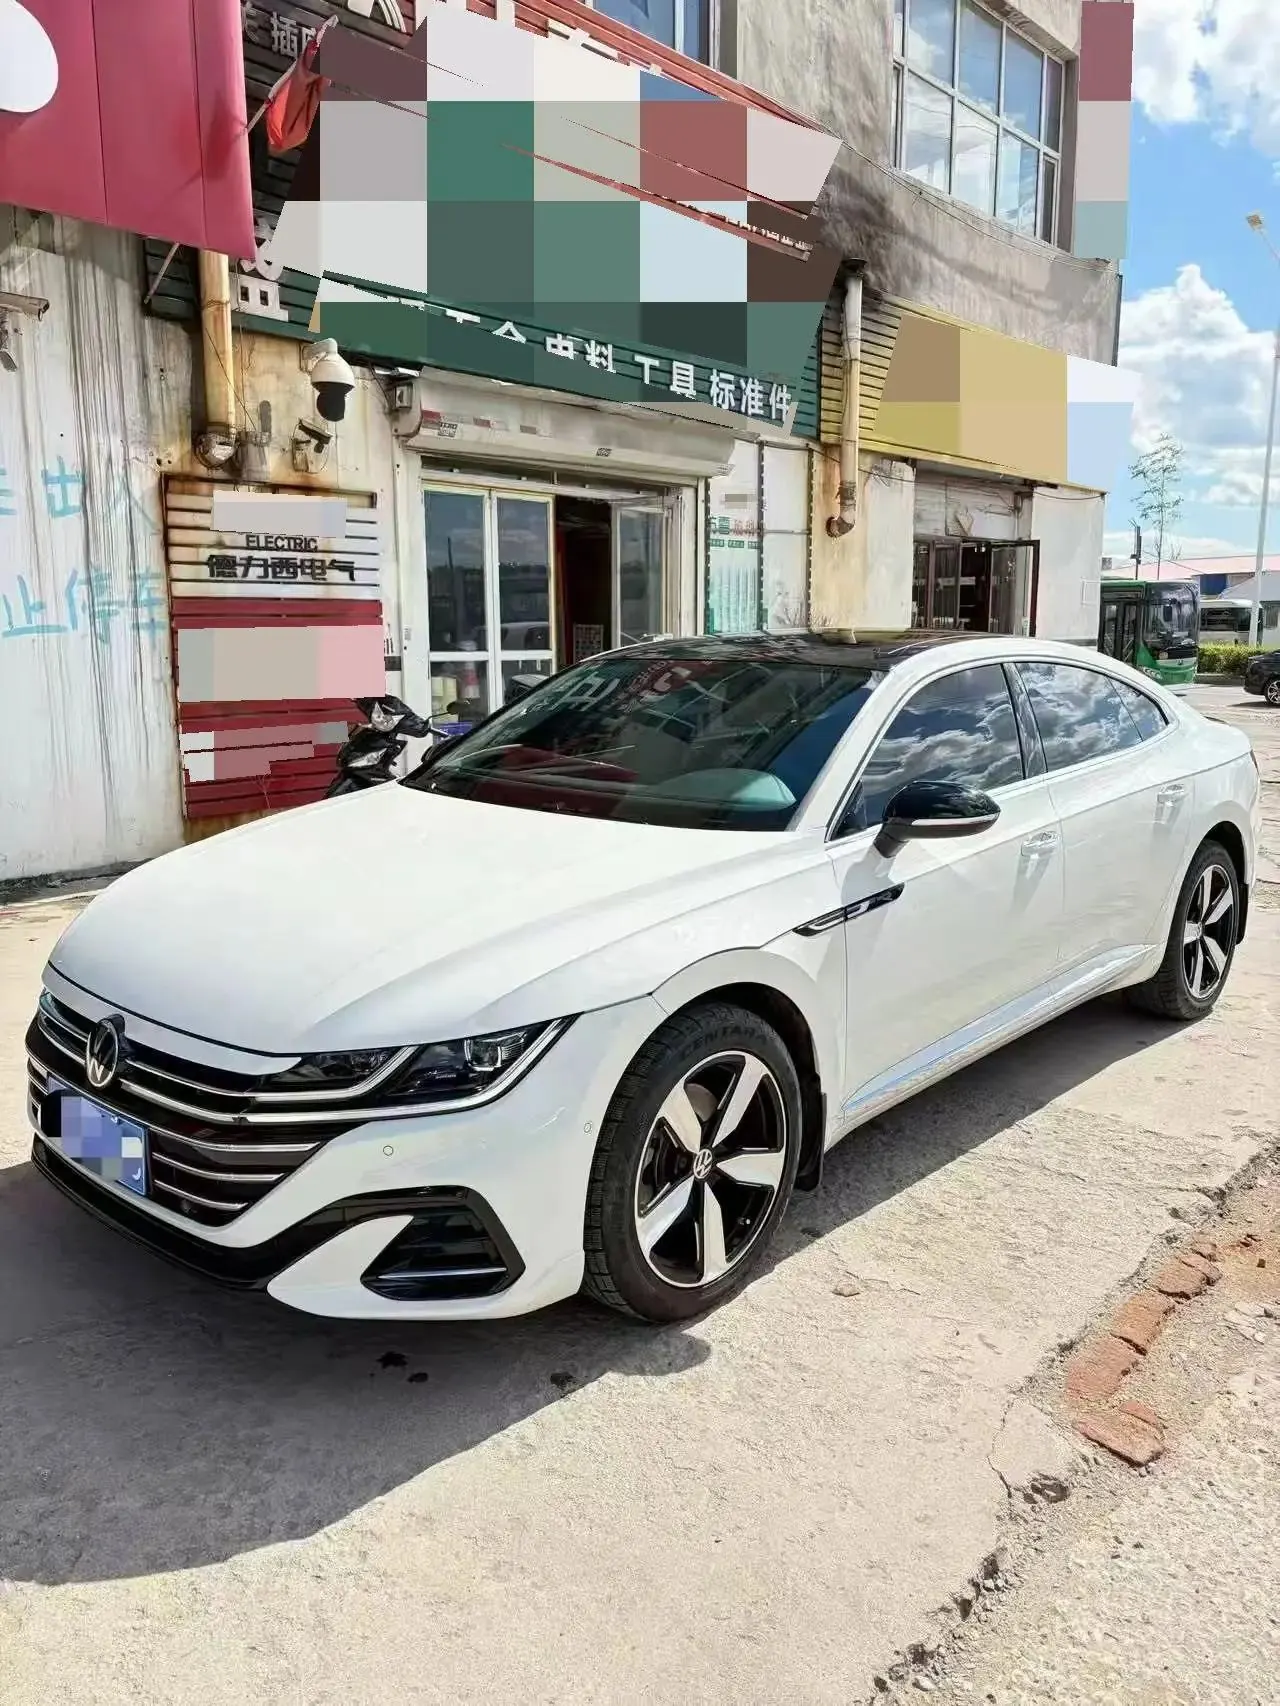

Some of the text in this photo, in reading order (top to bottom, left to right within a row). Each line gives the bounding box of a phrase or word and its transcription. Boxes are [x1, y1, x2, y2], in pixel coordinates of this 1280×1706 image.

[246, 534, 318, 552] ELECTRIC
[207, 555, 356, 582] 德力西电气
